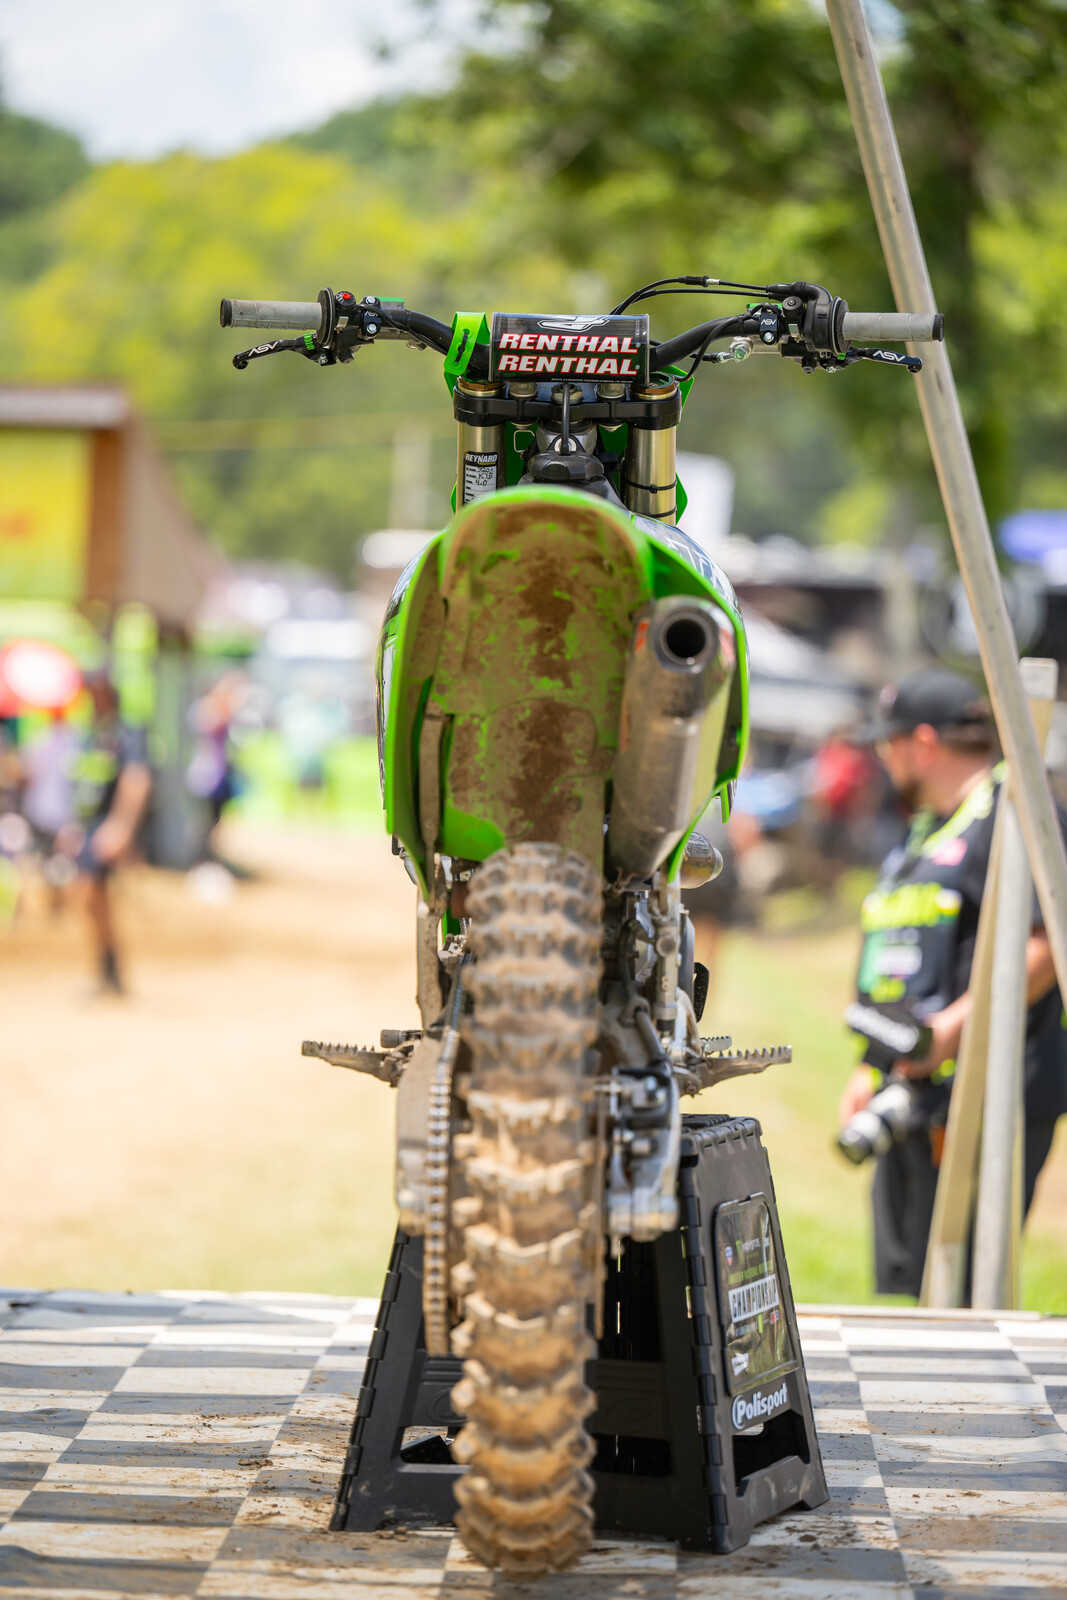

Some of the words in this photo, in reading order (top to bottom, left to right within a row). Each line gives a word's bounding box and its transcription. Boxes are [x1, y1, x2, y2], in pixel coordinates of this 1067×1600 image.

[248, 340, 279, 357] ASV
[498, 332, 638, 354] RENTHAL
[498, 354, 638, 375] RENTHAL
[872, 349, 906, 362] ASV
[465, 453, 498, 463] REYNARD
[733, 1382, 788, 1428] Polisport
